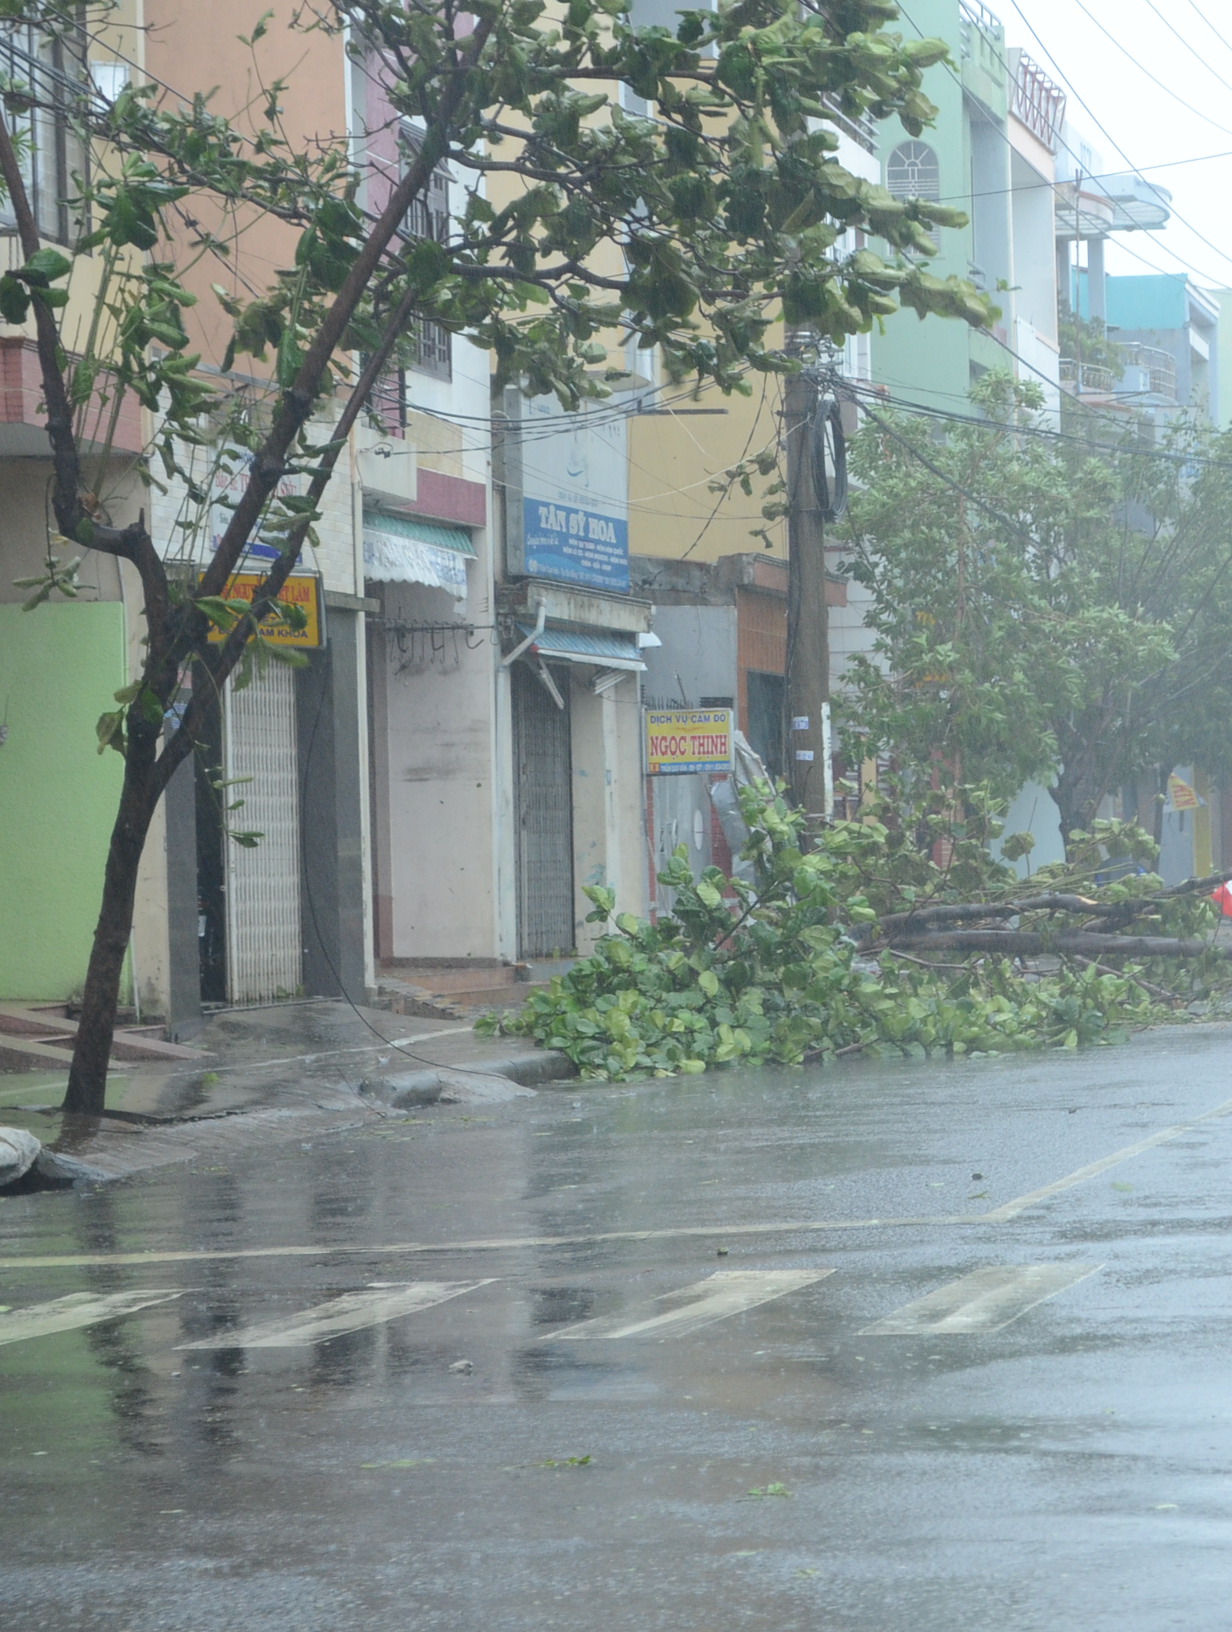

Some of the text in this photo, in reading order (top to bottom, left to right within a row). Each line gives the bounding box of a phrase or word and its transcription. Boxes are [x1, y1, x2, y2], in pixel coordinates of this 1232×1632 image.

[538, 504, 567, 533] TÂN
[587, 517, 617, 544] HOA
[277, 629, 309, 639] KHOA
[649, 734, 727, 760] NGỌC THỊNH
